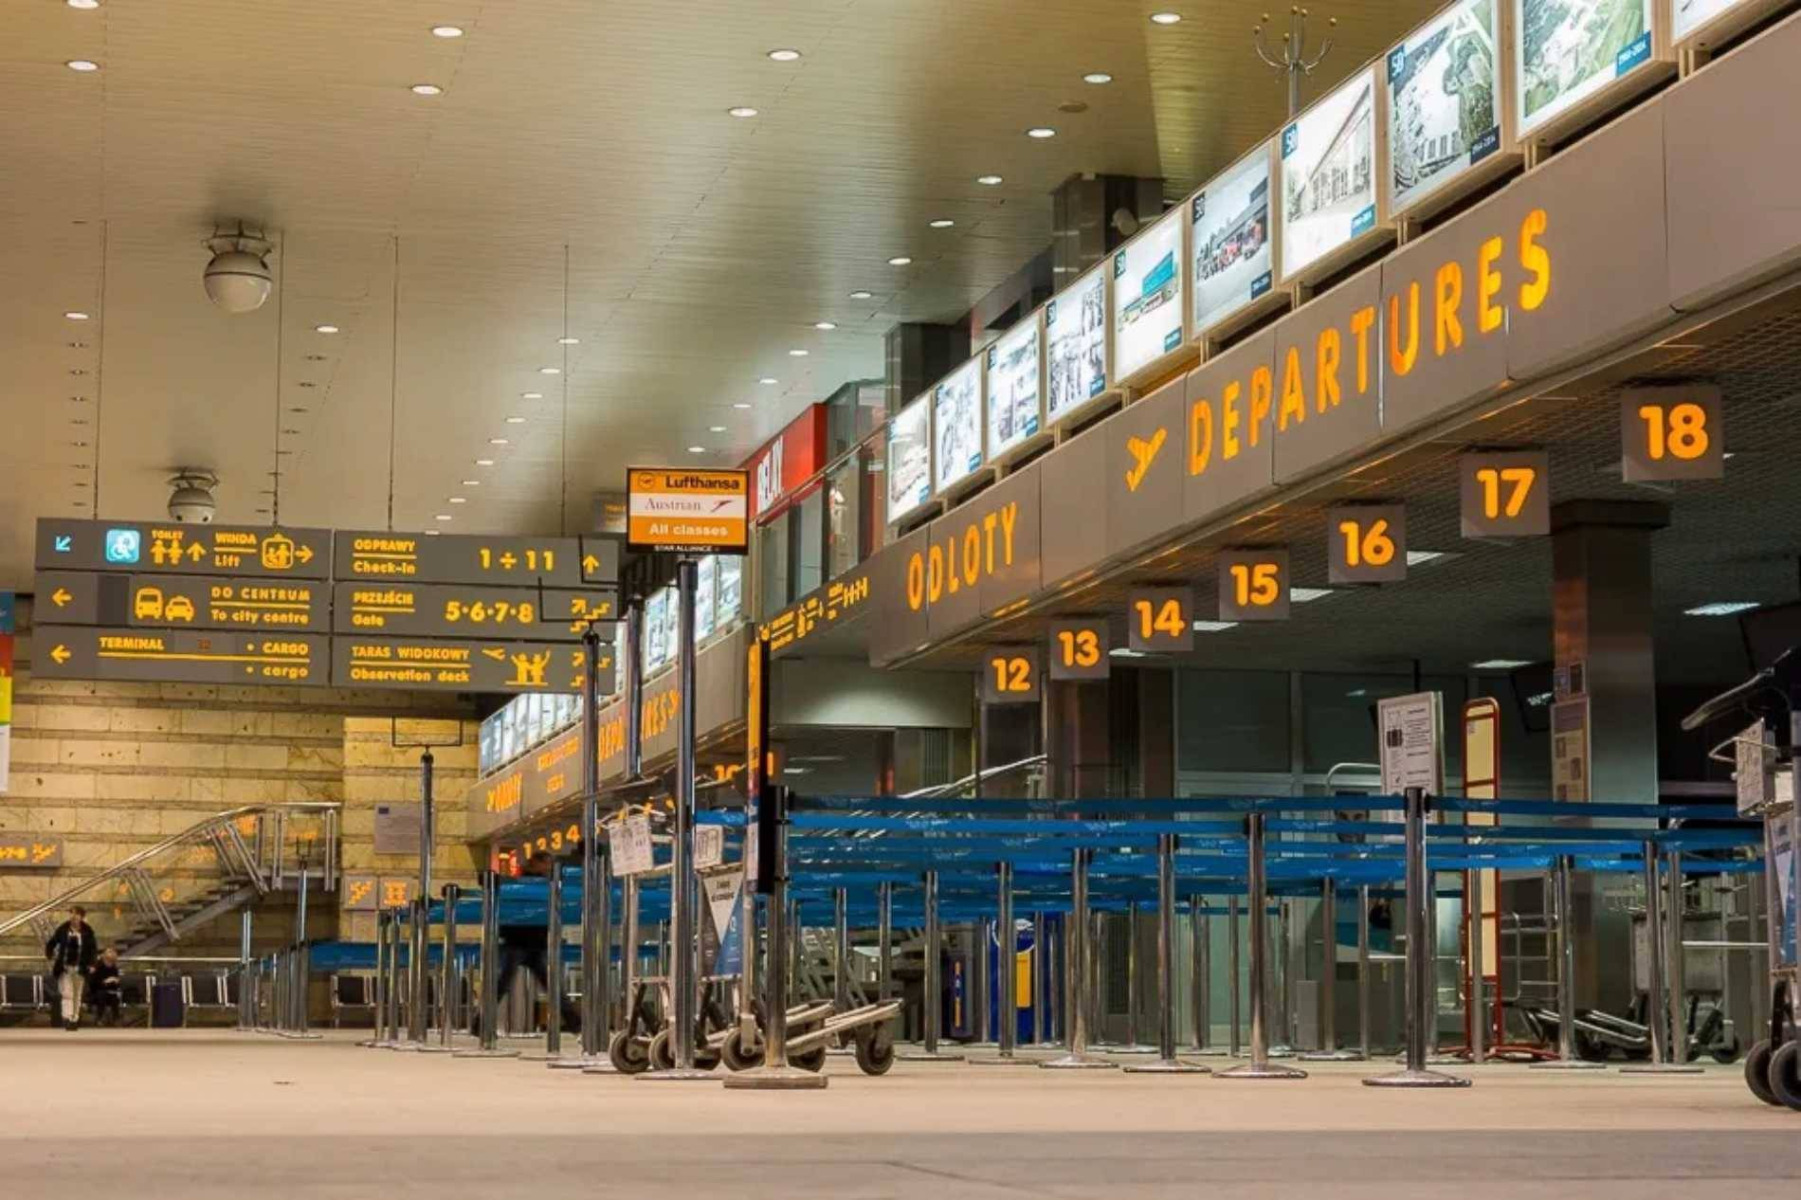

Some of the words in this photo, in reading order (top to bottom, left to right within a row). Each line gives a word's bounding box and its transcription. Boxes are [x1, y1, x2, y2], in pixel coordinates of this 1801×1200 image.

[1187, 208, 1551, 476] DEPARTURES
[1640, 404, 1708, 459] 18
[665, 475, 740, 490] Lufthansa
[1477, 469, 1534, 518] 17
[645, 498, 701, 511] Austrian
[215, 533, 257, 544] WINDA
[650, 524, 668, 536] All
[673, 525, 728, 537] classes
[354, 539, 415, 552] ODPRAWY
[1340, 520, 1394, 566] 16
[215, 555, 240, 566] Lift
[480, 548, 490, 568] 1
[526, 550, 553, 570] 11
[907, 501, 1018, 611] ODLOTY
[353, 558, 415, 574] Check-in
[1230, 564, 1278, 605] 15
[212, 587, 233, 598] DO
[241, 587, 310, 601] CENTRUM
[211, 609, 227, 621] To
[232, 610, 259, 623] city
[262, 608, 308, 624] centre
[1136, 600, 1185, 638] 14
[99, 637, 164, 650] TERMINAL
[261, 642, 308, 657] CARGO
[1058, 630, 1099, 666] 13
[352, 646, 391, 658] TARAS
[397, 647, 469, 660] WIDOKOWY
[263, 666, 308, 679] cargo
[351, 668, 431, 681] Observation
[992, 658, 1030, 691] 12
[551, 832, 562, 850] 3
[566, 825, 580, 842] 4
[524, 843, 531, 858] 1
